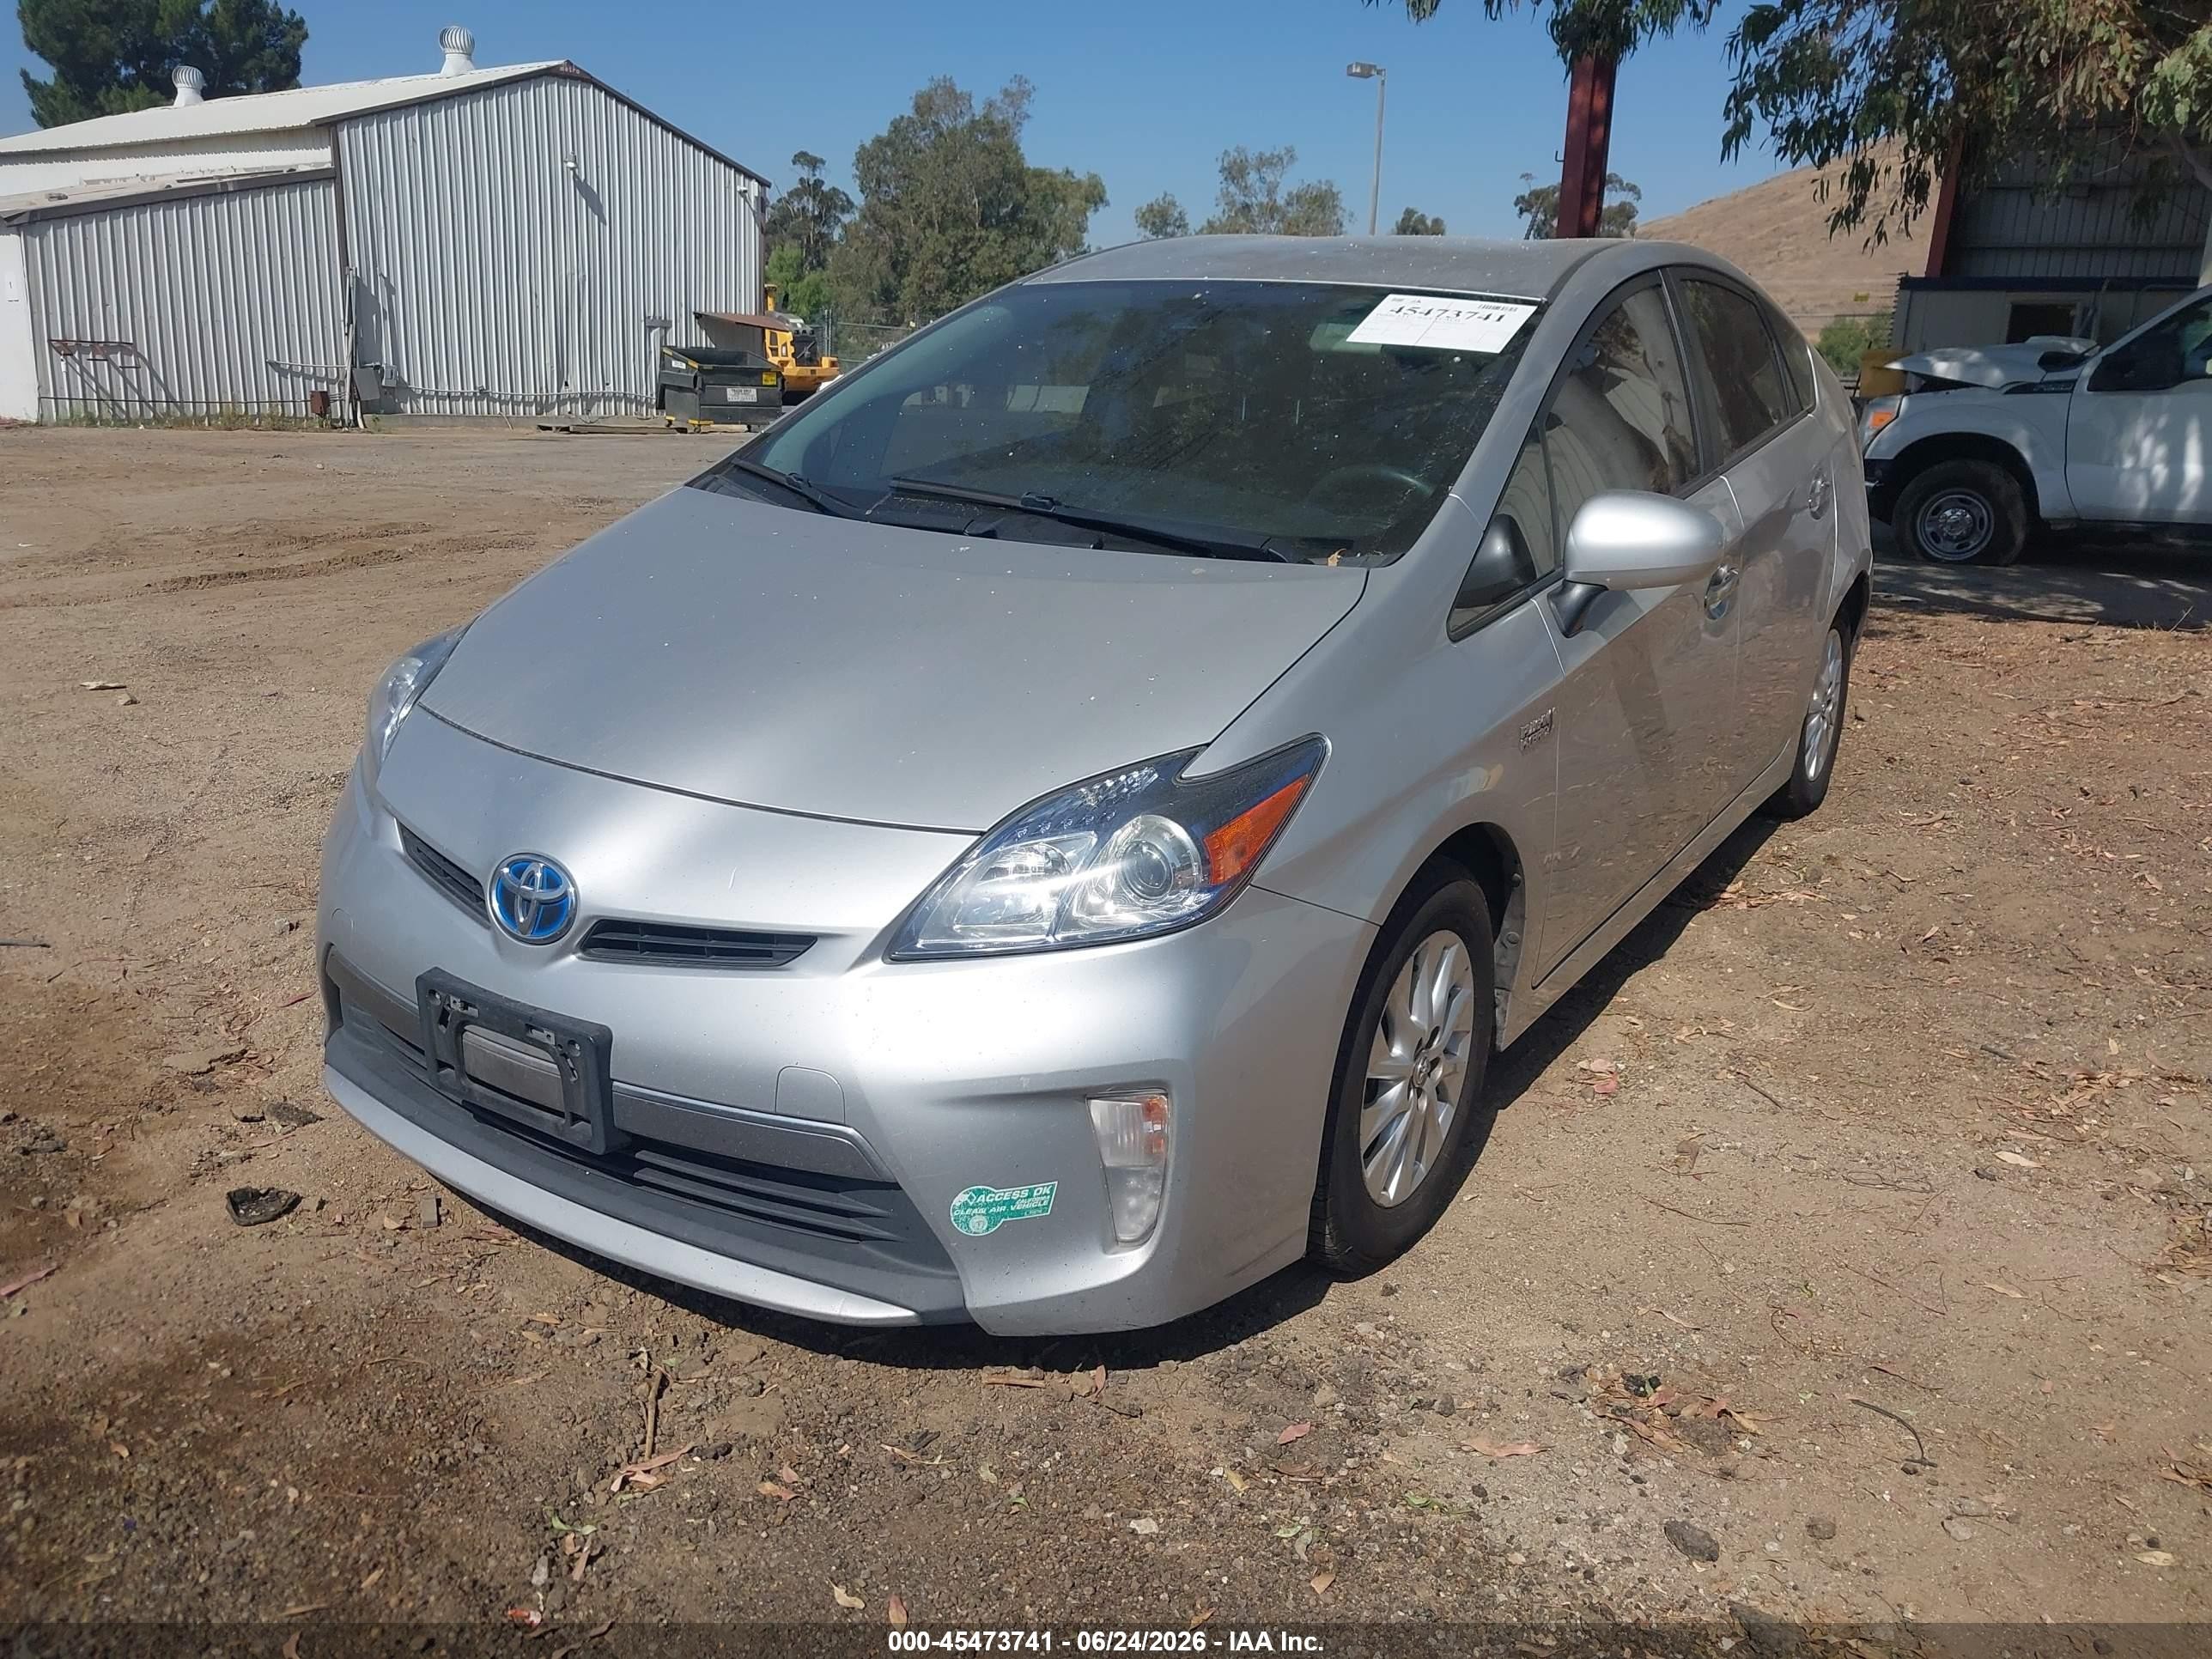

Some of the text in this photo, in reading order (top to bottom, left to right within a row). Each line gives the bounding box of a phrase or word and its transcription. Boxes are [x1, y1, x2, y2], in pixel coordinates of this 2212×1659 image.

[1389, 305, 1505, 323] 45473741
[976, 1185, 1053, 1203] ACCESS OK
[953, 1206, 987, 1217] CLEAN
[1010, 1199, 1049, 1212] VEHICLE
